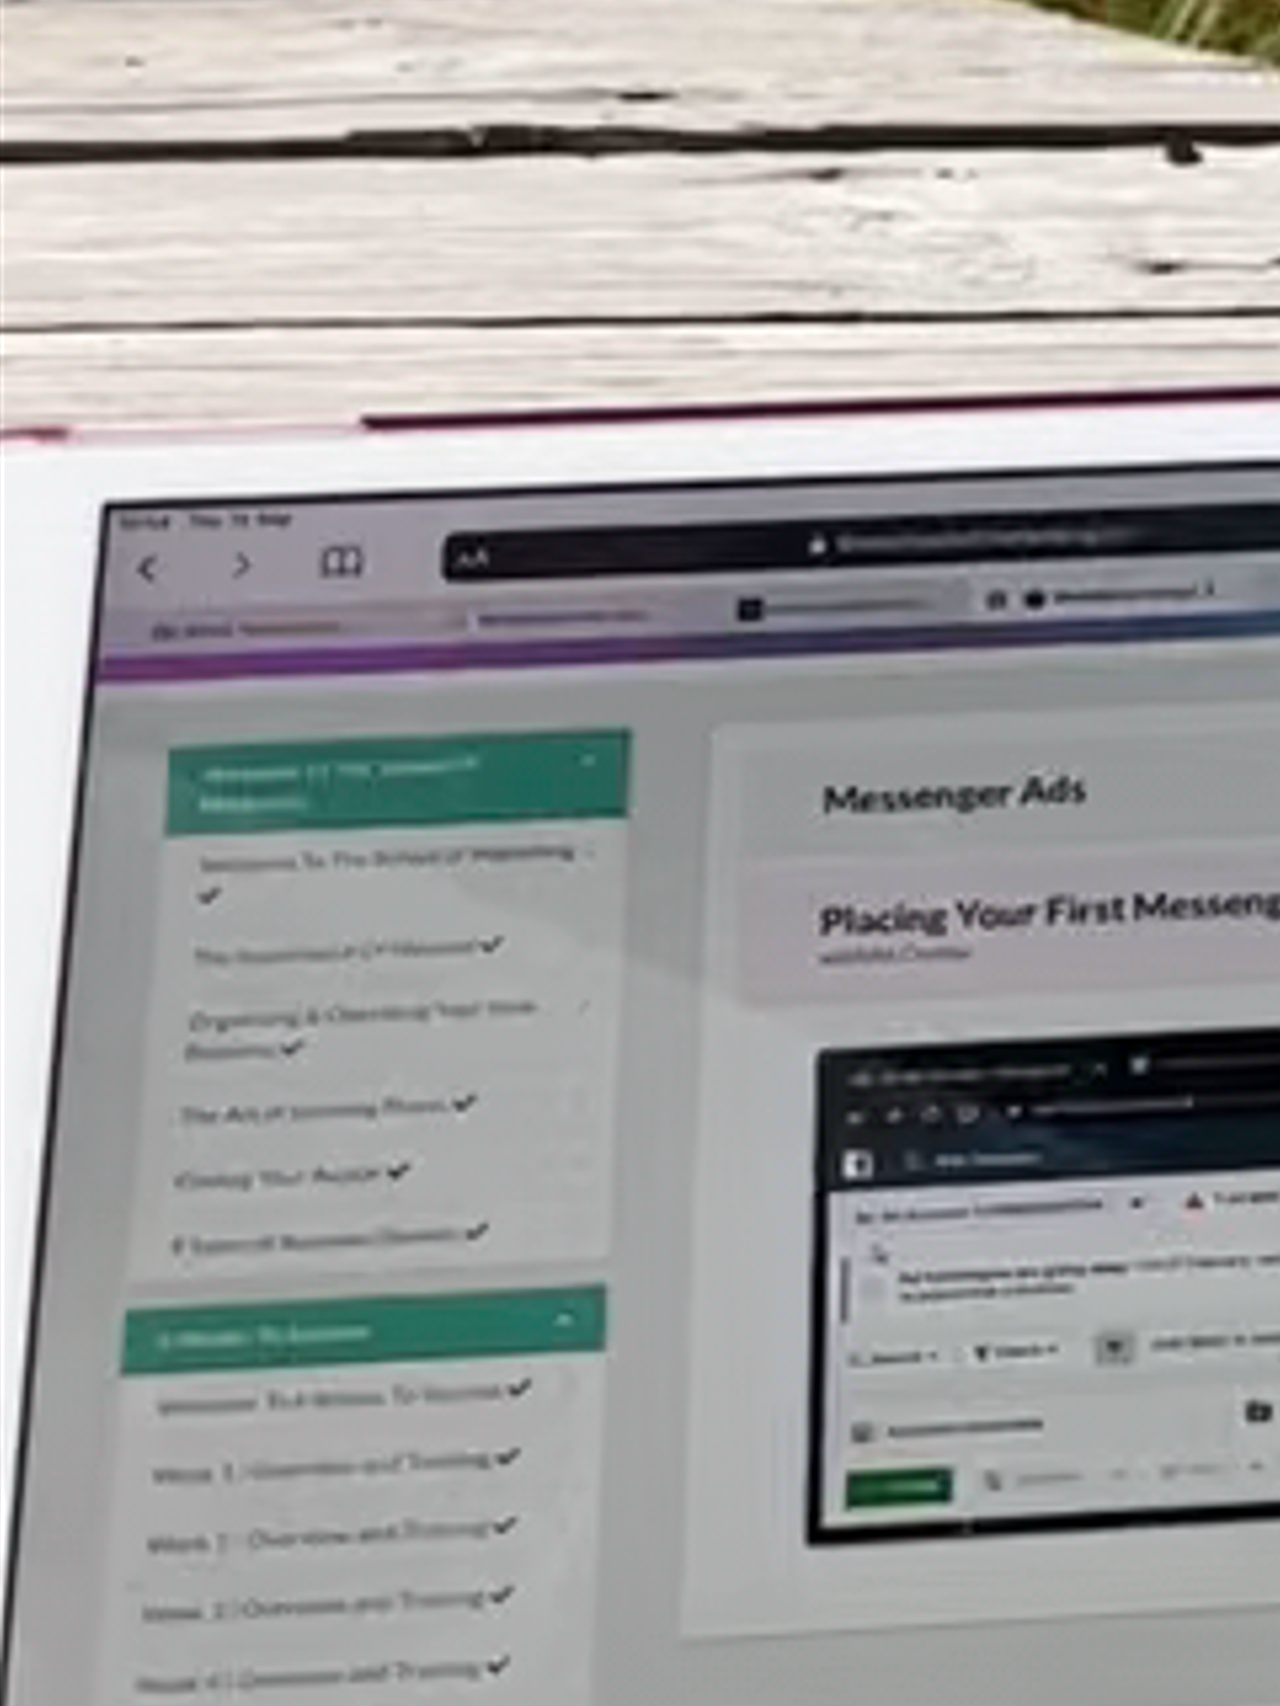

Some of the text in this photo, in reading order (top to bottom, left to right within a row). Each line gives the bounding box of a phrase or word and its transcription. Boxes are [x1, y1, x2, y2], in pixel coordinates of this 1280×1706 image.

[821, 775, 1087, 815] Messenger Ads
[819, 899, 948, 937] Placing
[955, 898, 1036, 930] Your
[1045, 892, 1126, 927] First
